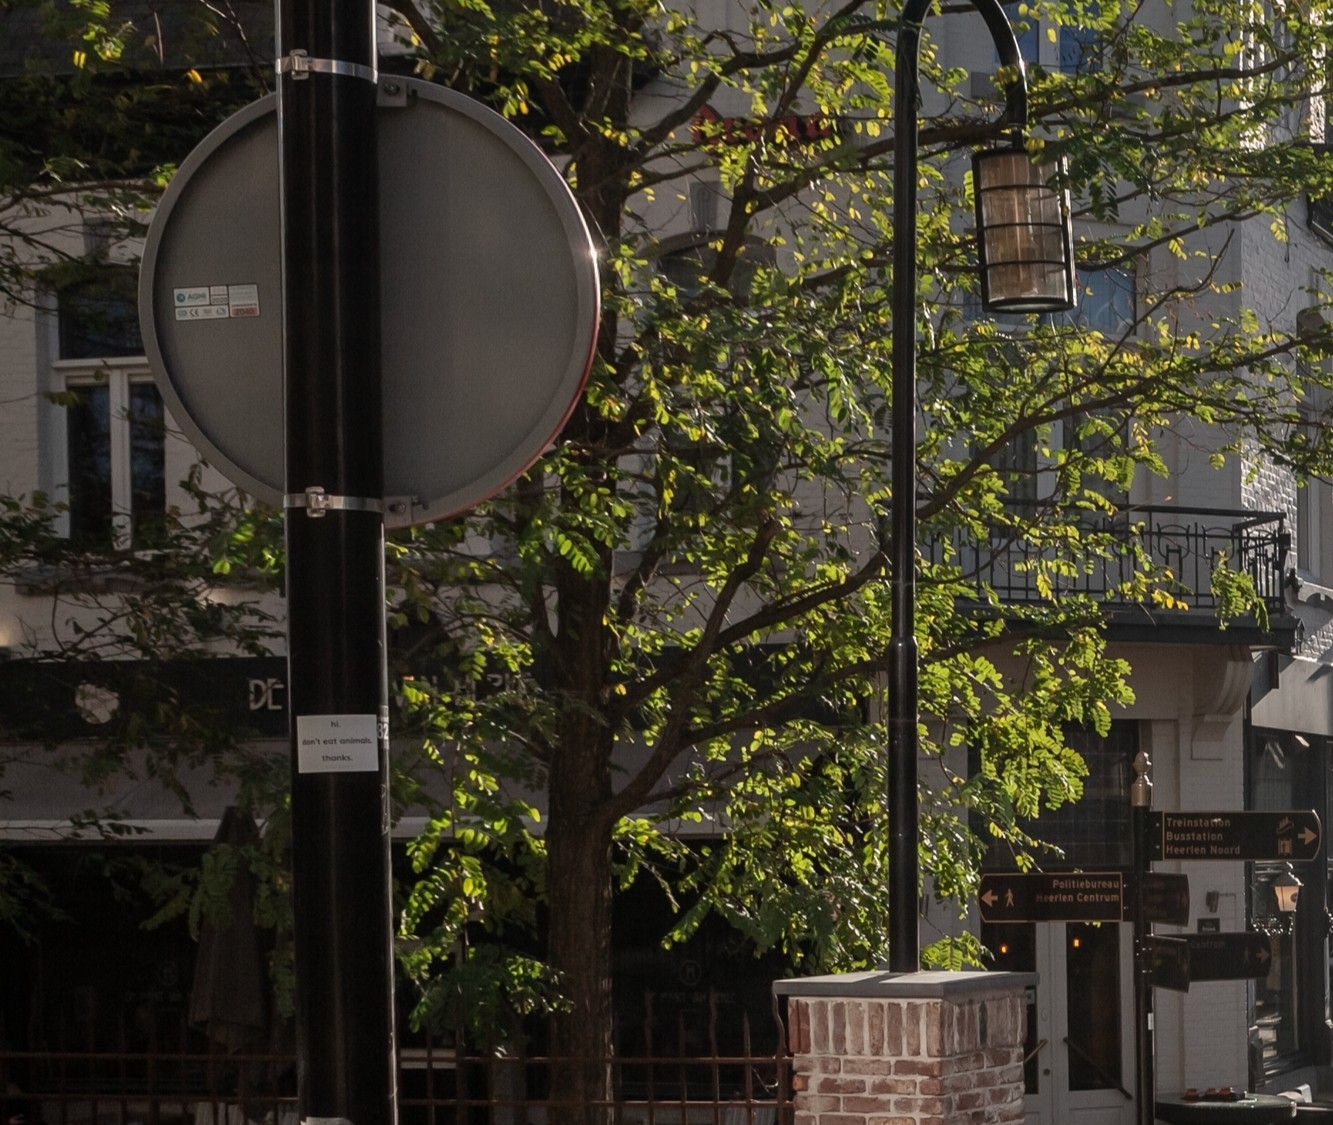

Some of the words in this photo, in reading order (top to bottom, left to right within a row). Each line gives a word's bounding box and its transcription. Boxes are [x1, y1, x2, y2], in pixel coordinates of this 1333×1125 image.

[322, 754, 352, 762] thanks.
[1166, 818, 1231, 827] Treinstation
[1166, 831, 1224, 840] Busstation
[1165, 845, 1207, 854] Heerlen
[1210, 845, 1241, 854] Noord
[1052, 879, 1120, 889] Politiebureau
[1035, 892, 1074, 903] Heerlen
[1076, 892, 1120, 903] Centrum
